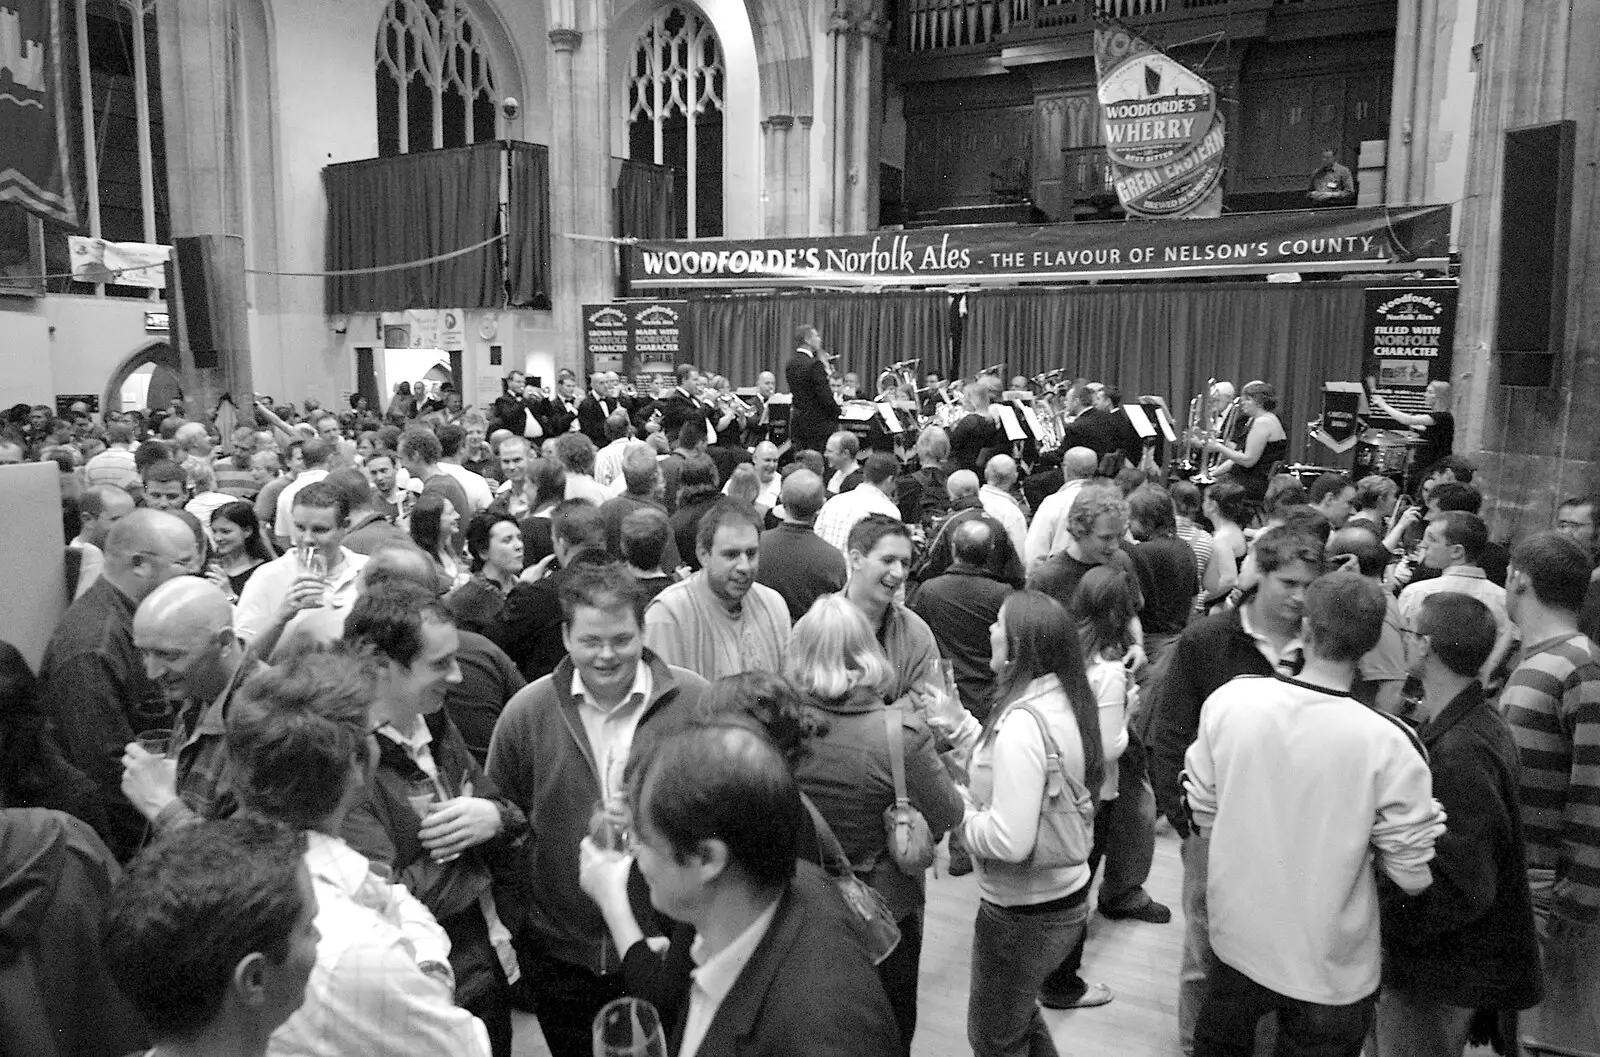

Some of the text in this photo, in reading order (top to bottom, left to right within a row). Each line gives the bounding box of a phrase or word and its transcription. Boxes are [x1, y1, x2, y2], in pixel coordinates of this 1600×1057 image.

[1106, 98, 1197, 119] WOODFORDE'S
[1105, 117, 1196, 144] WHERRY
[1115, 169, 1163, 203] GREAT
[642, 247, 821, 275] WOODFORDE'S
[824, 235, 916, 277] Norfolk
[918, 233, 971, 271] Ales
[991, 252, 1025, 268] THE
[1033, 248, 1121, 267] FLAVOUR
[1129, 247, 1155, 263] OF
[1164, 241, 1269, 262] NELSON'S
[1278, 236, 1374, 256] COUNTY
[1377, 293, 1443, 314] Woodforde's
[1374, 326, 1442, 335] FILLED WITH
[588, 344, 628, 352] CHARACTER
[635, 344, 679, 352] CHARACTER
[1374, 335, 1440, 346] NORFOLK
[1373, 347, 1439, 356] CHARACTER
